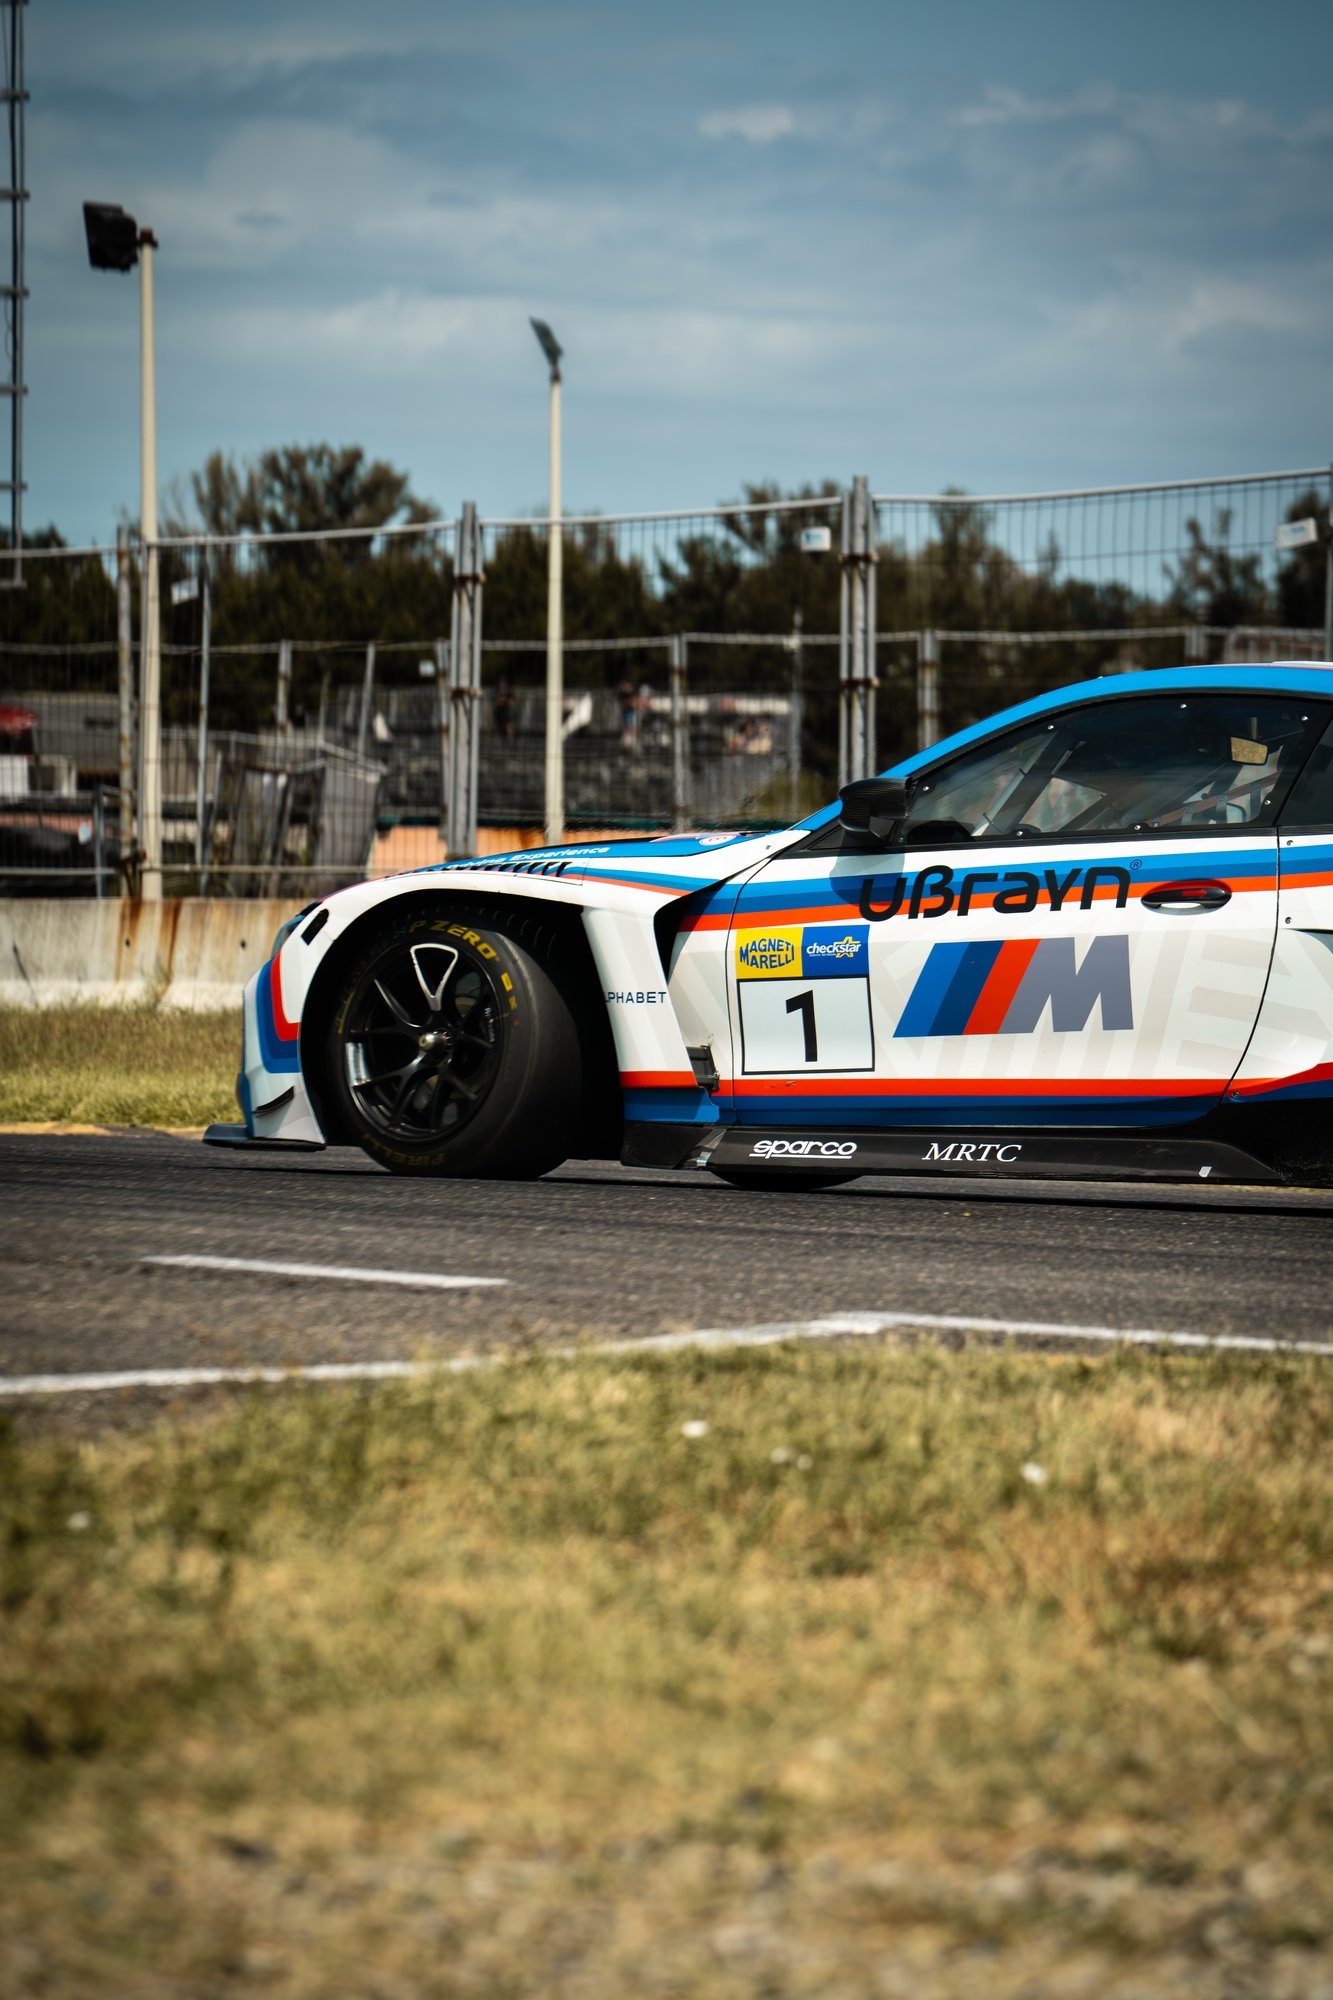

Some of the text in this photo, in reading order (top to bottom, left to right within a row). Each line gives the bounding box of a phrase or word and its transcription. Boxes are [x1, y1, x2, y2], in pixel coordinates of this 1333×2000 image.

[510, 847, 611, 861] Experience
[407, 920, 497, 960] P ZERO
[740, 938, 794, 957] MAGNETI
[806, 941, 862, 955] checkstar
[740, 950, 794, 968] MARELLI
[997, 934, 1134, 1035] M
[605, 991, 667, 1004] PHABET
[784, 988, 819, 1062] 1
[749, 1139, 858, 1159] sparco
[921, 1142, 1023, 1162] MRTC
